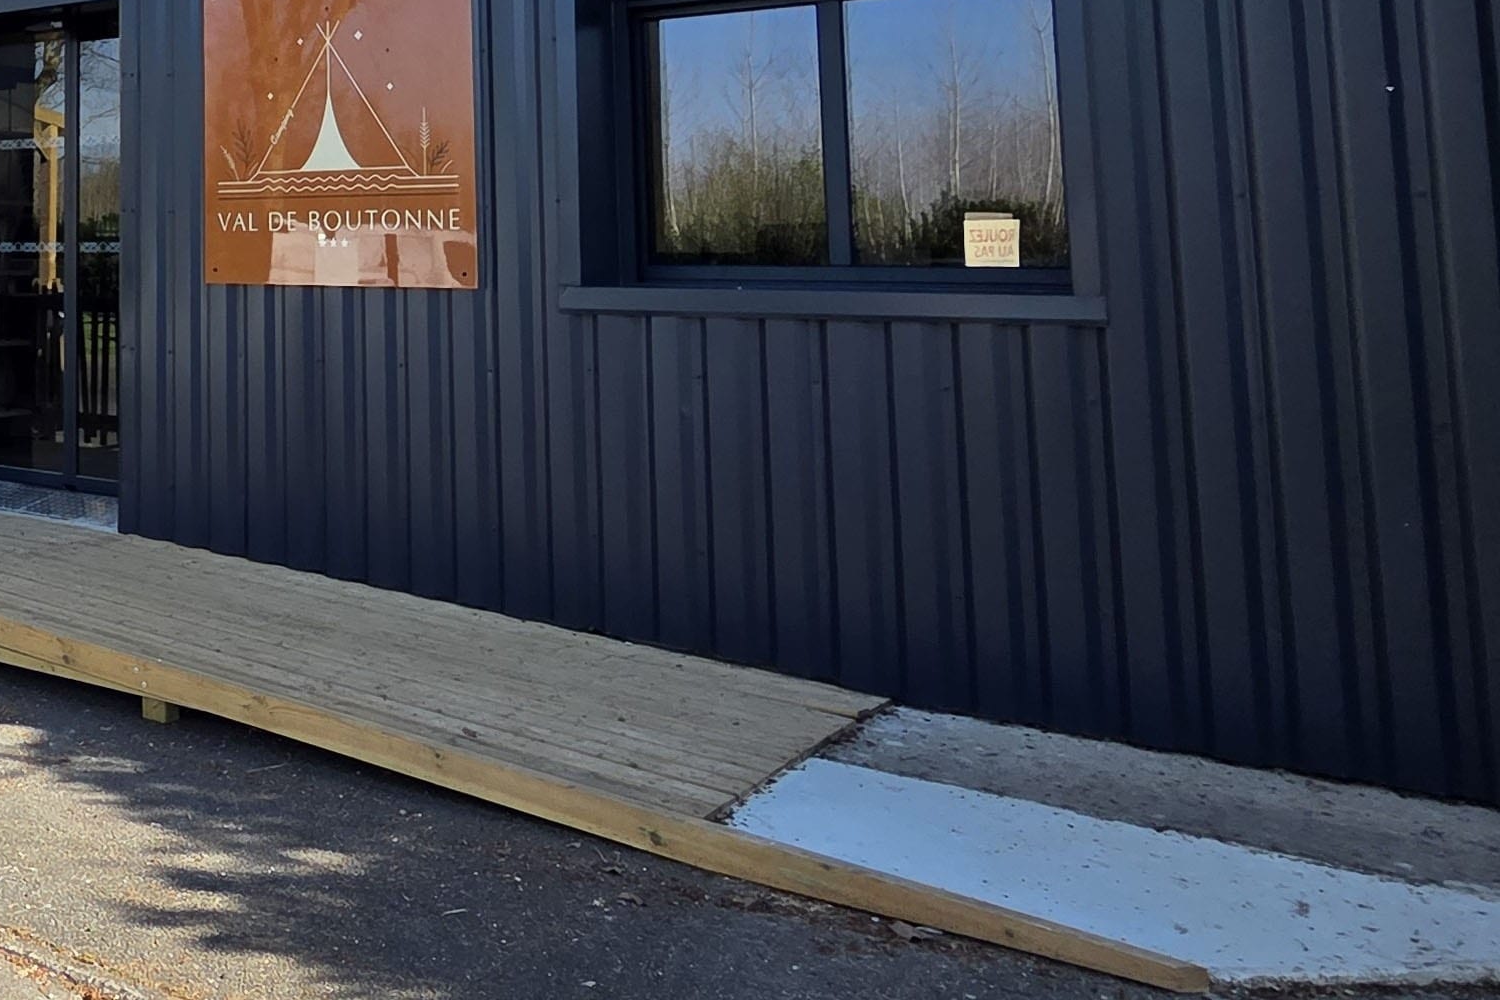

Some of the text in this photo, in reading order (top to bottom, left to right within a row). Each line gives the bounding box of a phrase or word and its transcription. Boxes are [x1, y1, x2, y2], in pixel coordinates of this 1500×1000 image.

[217, 208, 461, 232] VAL DE BOUTONNE
